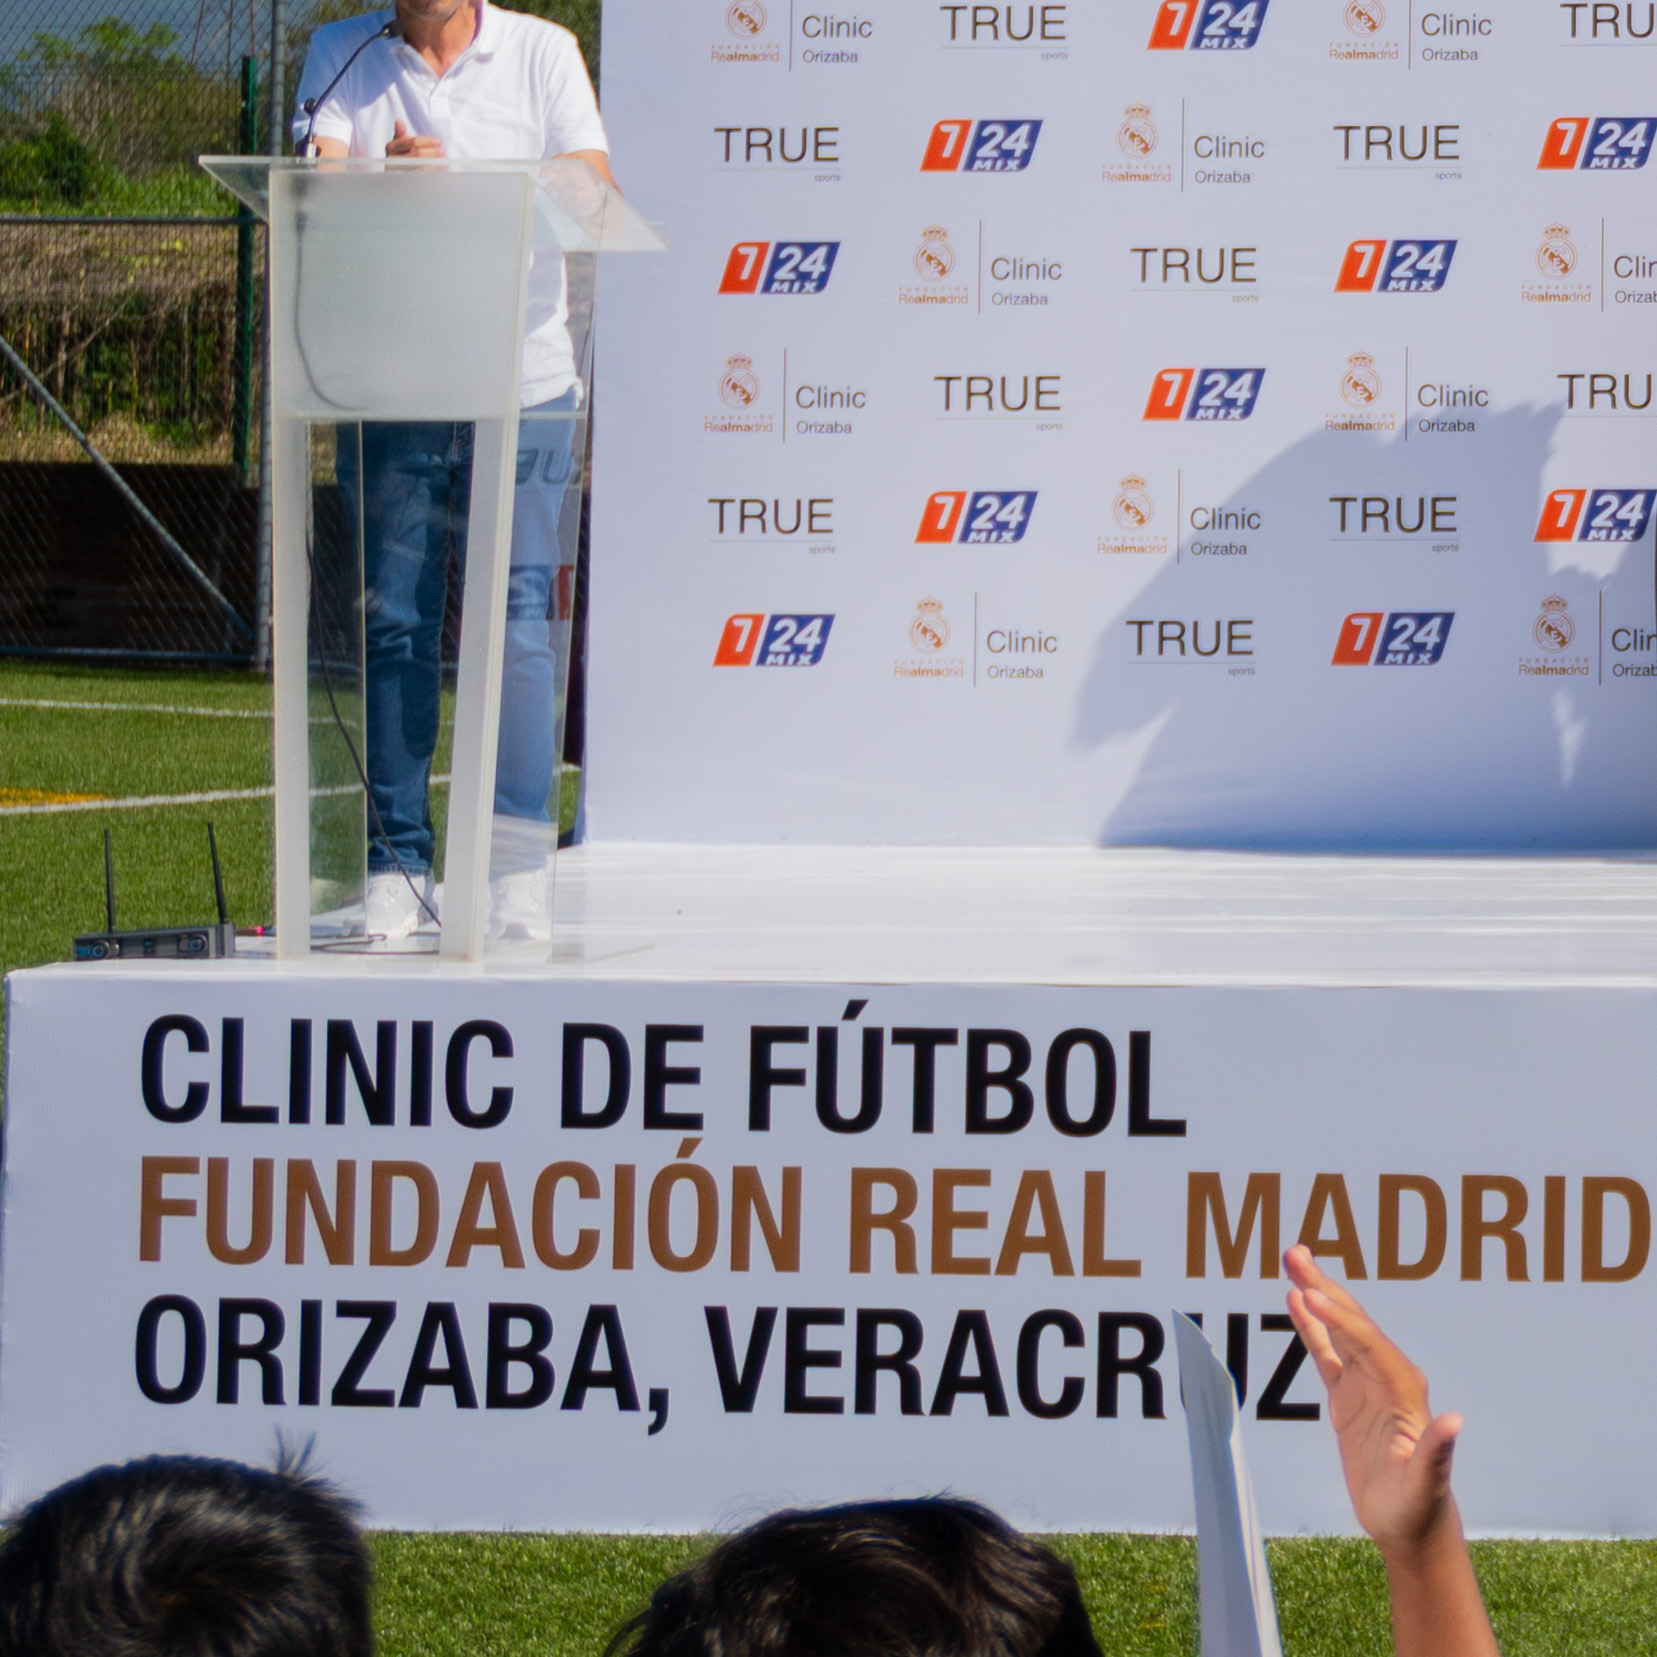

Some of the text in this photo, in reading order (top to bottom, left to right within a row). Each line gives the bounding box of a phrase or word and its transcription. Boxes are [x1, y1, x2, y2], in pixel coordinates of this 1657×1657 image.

[802, 15, 872, 38] Clinic
[940, 6, 1066, 41] TRUE
[1422, 13, 1491, 36] Clinic
[1199, 37, 1249, 48] MIX
[803, 50, 858, 63] Orizaba
[1041, 52, 1068, 61] sports
[1330, 49, 1398, 60] Realmadrid
[714, 127, 838, 162] TRUE
[1194, 136, 1264, 158] Clinic
[1333, 125, 1459, 160] TRUE
[1195, 170, 1250, 183] Orizaba
[991, 258, 1061, 280] Clinic
[1131, 248, 1256, 283] TRUE
[992, 292, 1048, 305] Orizaba
[796, 386, 865, 408] Clinic
[934, 376, 1060, 411] TRUE
[1418, 384, 1488, 408] Clinic
[705, 422, 772, 432] Realmadrid
[797, 421, 852, 434] Orizaba
[708, 499, 833, 534] TRUE
[1191, 507, 1261, 530] Clinic
[1329, 497, 1457, 533] TRUE
[967, 531, 1017, 542] MIX
[987, 630, 1057, 653] Clinic
[1126, 620, 1253, 656] TRUE
[895, 667, 963, 677] Realmadrid
[987, 665, 1043, 678] Orizaba
[141, 1000, 1186, 1137] CLINIC DE FÚTBOL
[140, 1138, 1653, 1284] FUNDACIÓN REAL MADRID
[135, 1295, 668, 1435] ORIZABA,
